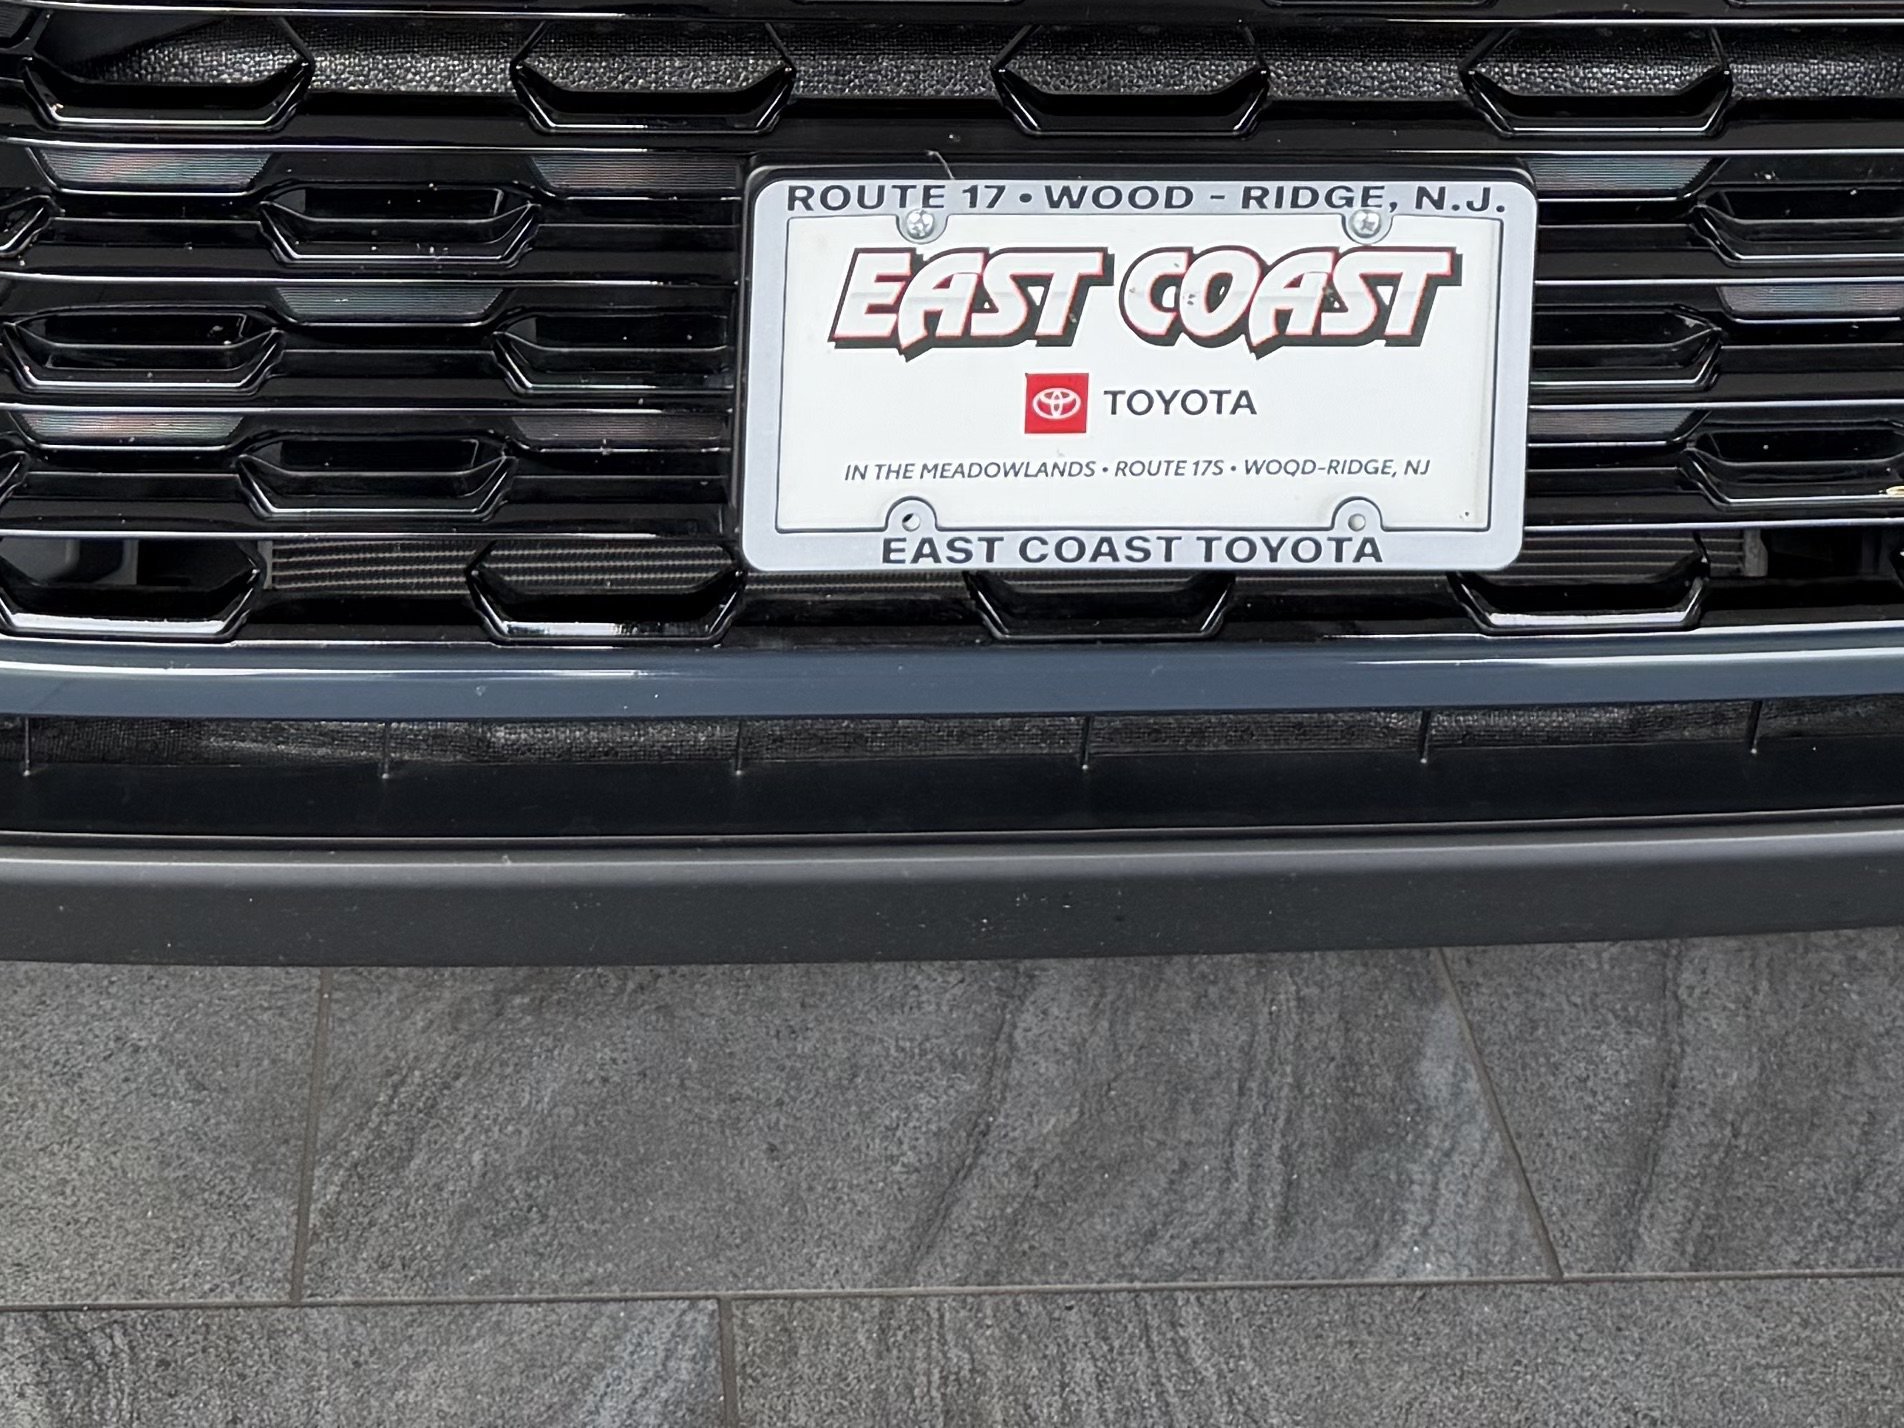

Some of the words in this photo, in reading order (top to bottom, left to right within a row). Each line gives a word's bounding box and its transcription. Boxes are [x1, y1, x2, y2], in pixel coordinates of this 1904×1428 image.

[787, 183, 946, 212] ROUTE
[962, 183, 1006, 211] 17
[1045, 184, 1193, 211] WOOD
[1241, 184, 1399, 214] RIDGE,
[1416, 185, 1506, 213] N.J.
[830, 246, 1114, 360] EAST
[1119, 245, 1463, 359] COAST
[1103, 388, 1257, 417] TOYOTA
[844, 463, 869, 482] IN
[874, 462, 914, 481] THE
[919, 460, 1096, 480] MEADOWLANDS
[1114, 460, 1190, 478] ROUTE
[1191, 459, 1224, 477] 17S
[1243, 458, 1399, 478] WOOD-RIDGE,
[1402, 458, 1431, 477] NJ
[882, 536, 1005, 565] EAST
[1017, 536, 1184, 565] COAST
[1195, 536, 1384, 565] TOYOTA
